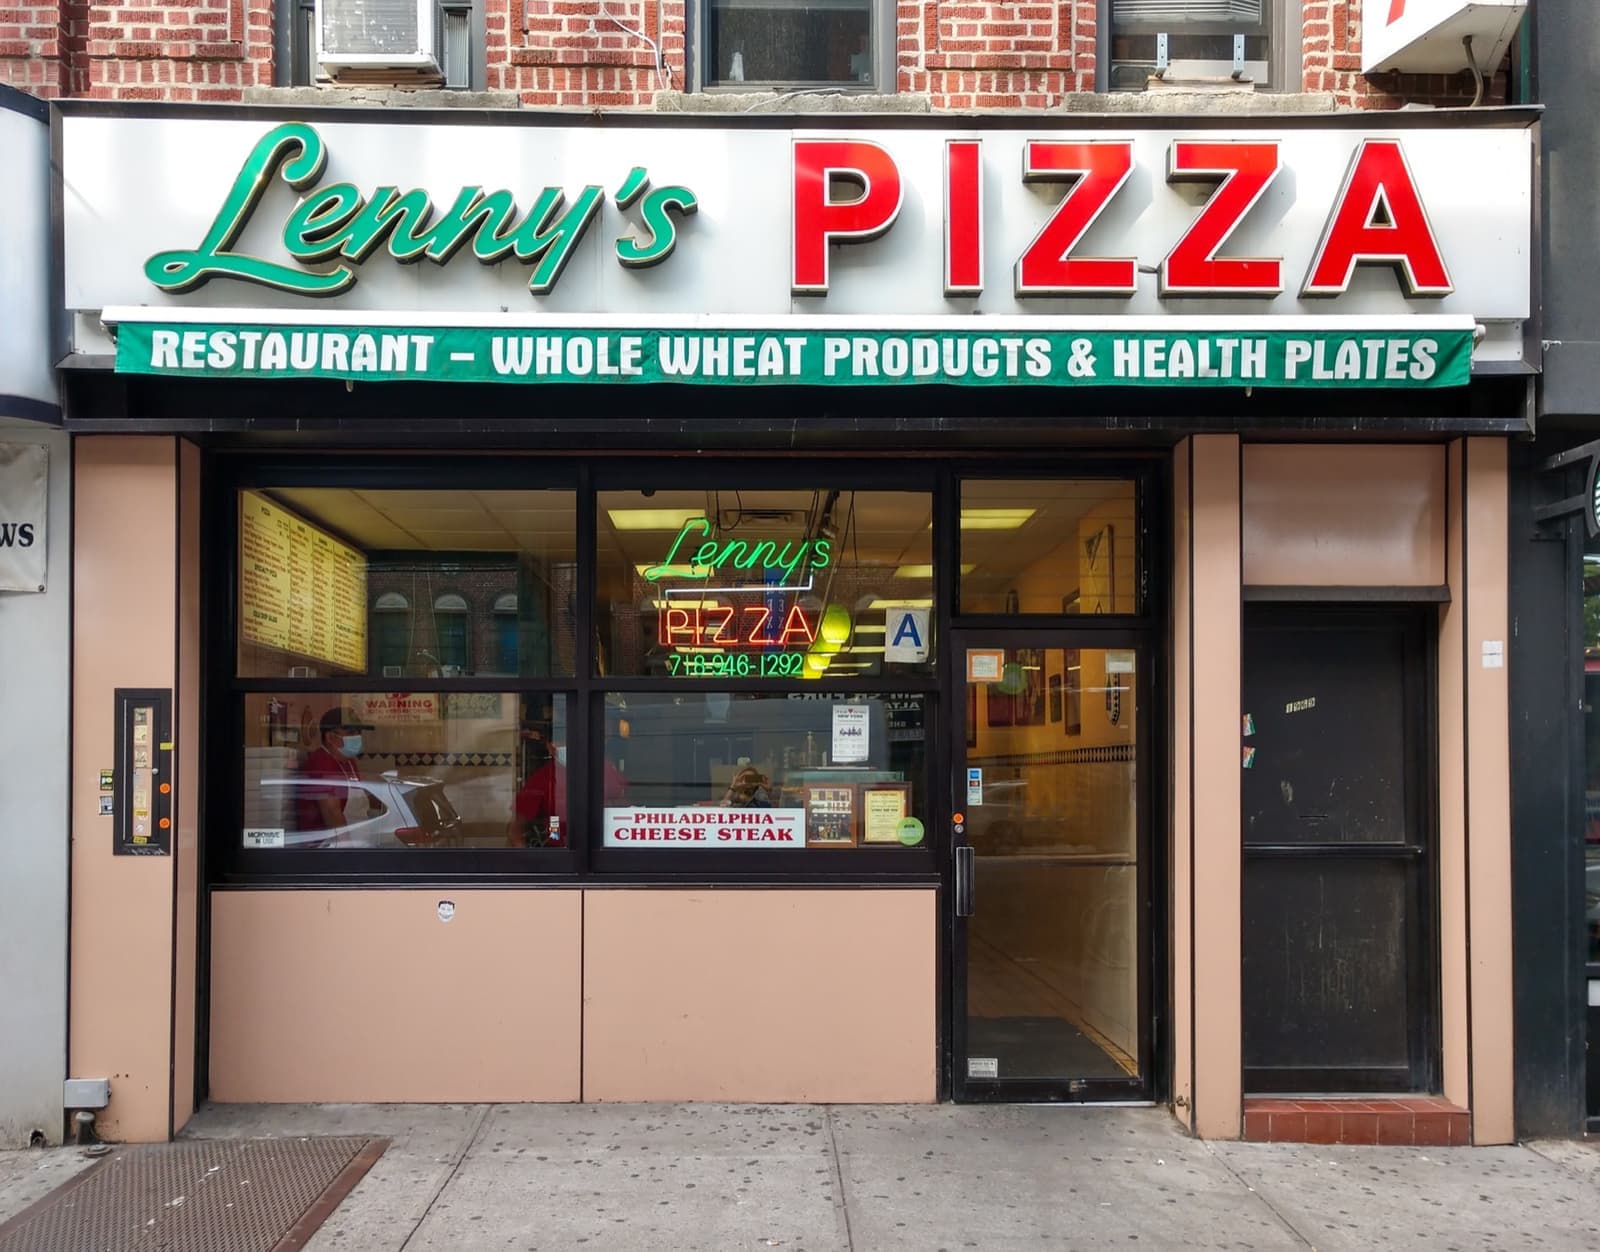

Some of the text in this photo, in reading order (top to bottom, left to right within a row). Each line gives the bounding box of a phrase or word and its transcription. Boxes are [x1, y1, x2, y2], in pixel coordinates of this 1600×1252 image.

[143, 121, 1454, 298] Lenny's PIZZA
[152, 330, 434, 371] RESTAURANT
[492, 336, 643, 376] WHOLE
[658, 337, 807, 377] WHEAT
[825, 337, 1052, 377] PRODUCTS
[1068, 338, 1096, 378] &
[1113, 339, 1267, 378] HEALTH
[1285, 339, 1438, 380] PLATES
[665, 605, 815, 645] PIZZA
[892, 613, 922, 647] A
[668, 652, 804, 677] 718-946-1292
[366, 700, 433, 709] WARNING
[633, 812, 775, 825] PHILADELPHIA
[614, 827, 794, 842] CHEESE STEAK
